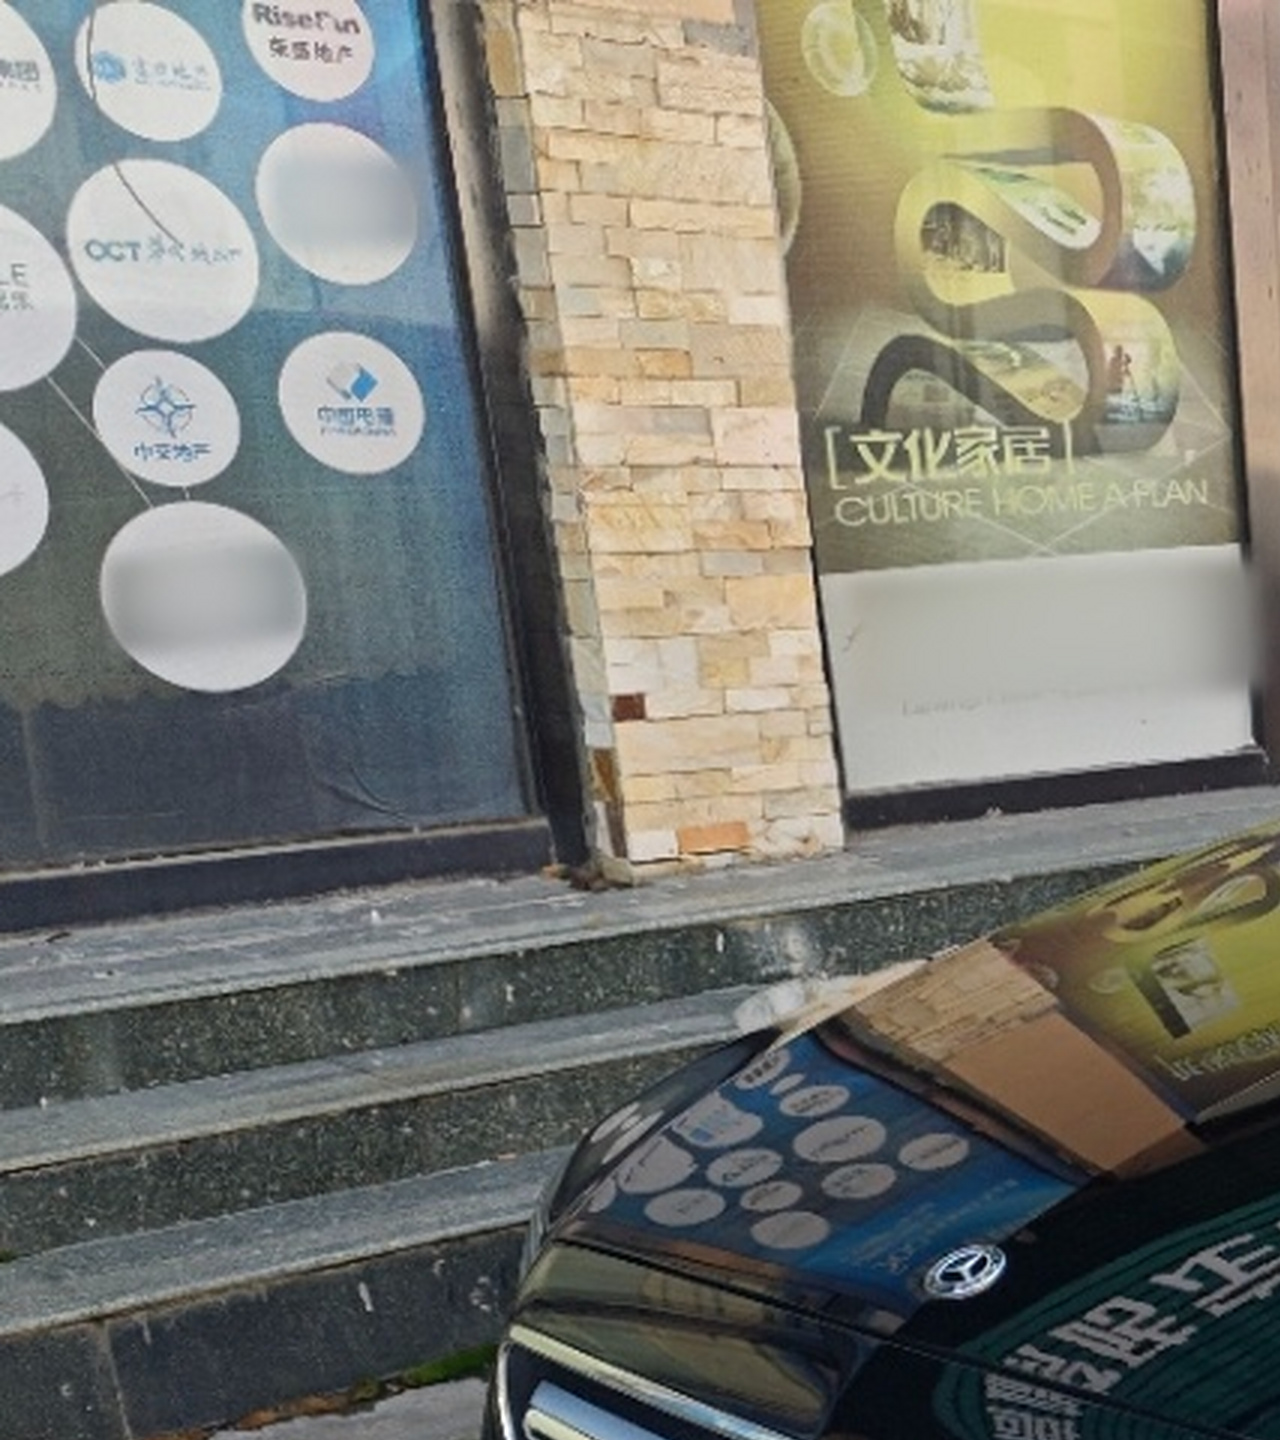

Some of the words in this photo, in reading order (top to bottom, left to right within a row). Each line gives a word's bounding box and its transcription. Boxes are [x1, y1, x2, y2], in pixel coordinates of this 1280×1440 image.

[84, 238, 141, 262] OCT
[834, 487, 982, 528] CULTURE
[992, 484, 1096, 516] HOME
